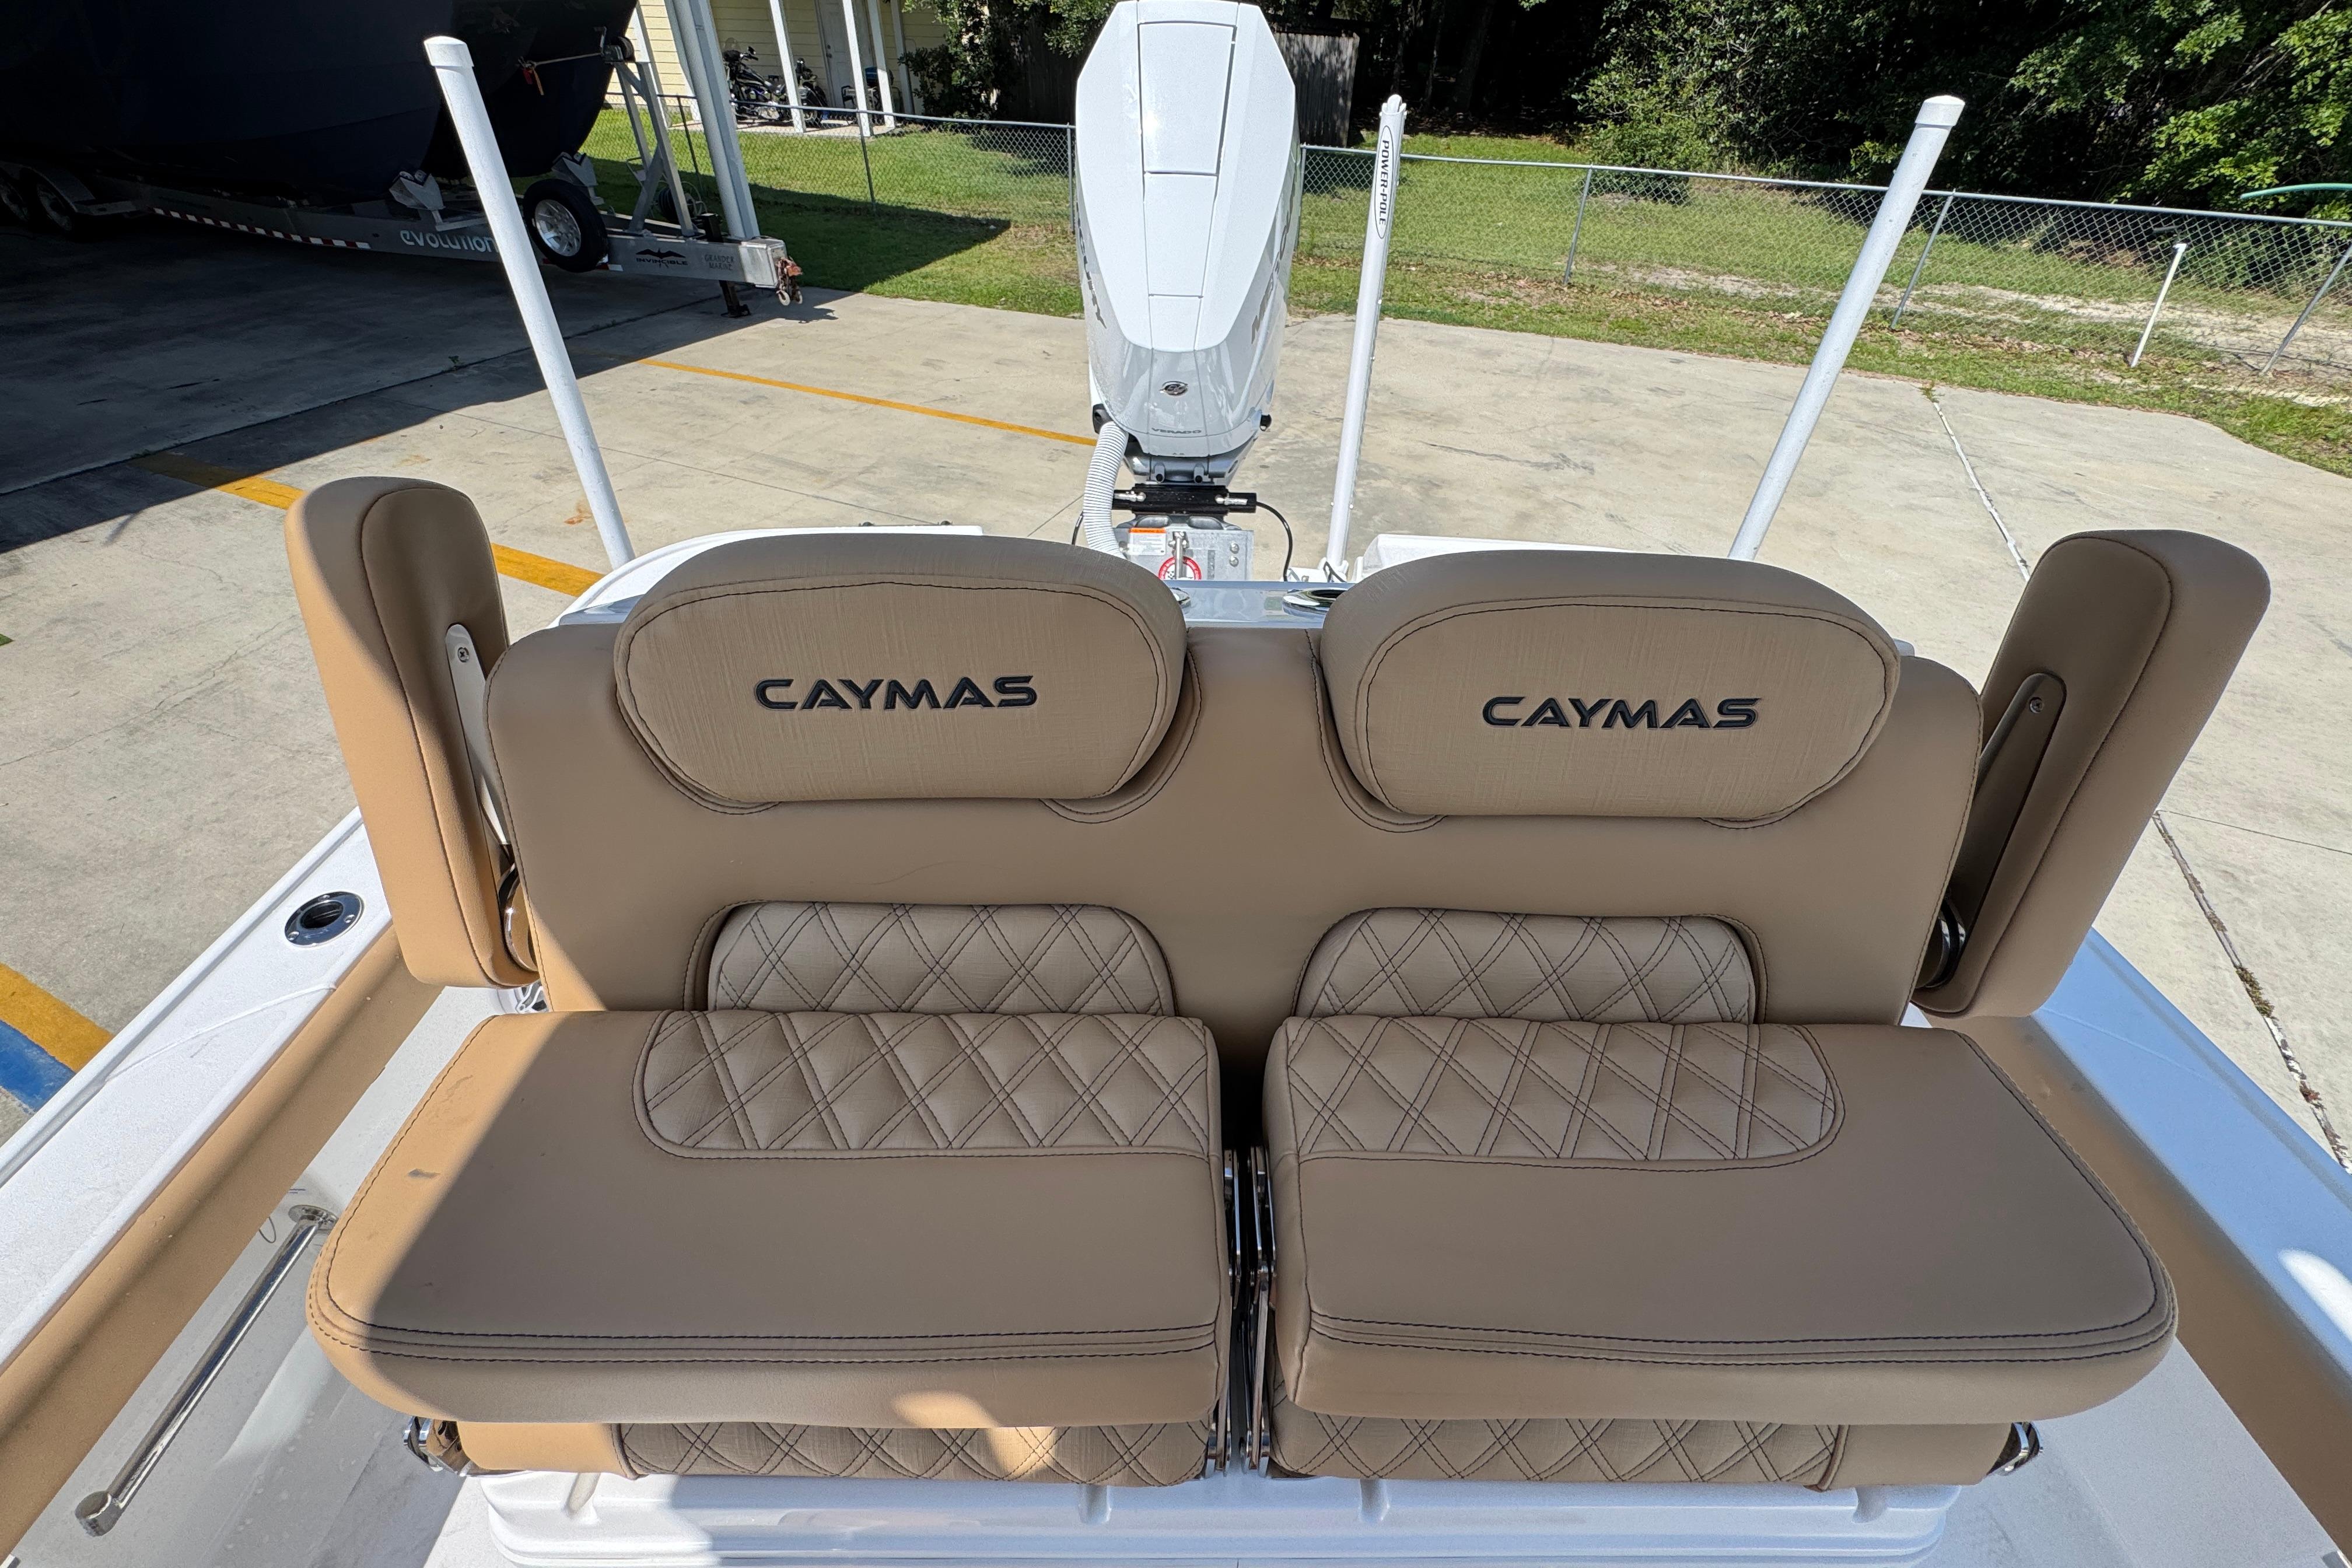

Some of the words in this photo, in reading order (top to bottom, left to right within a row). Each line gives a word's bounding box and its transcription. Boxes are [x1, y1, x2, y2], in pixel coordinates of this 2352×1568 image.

[1378, 139, 1390, 225] POWER-POLE
[756, 675, 1038, 710] CAYMAS
[1482, 696, 1762, 729] CAYMAS
